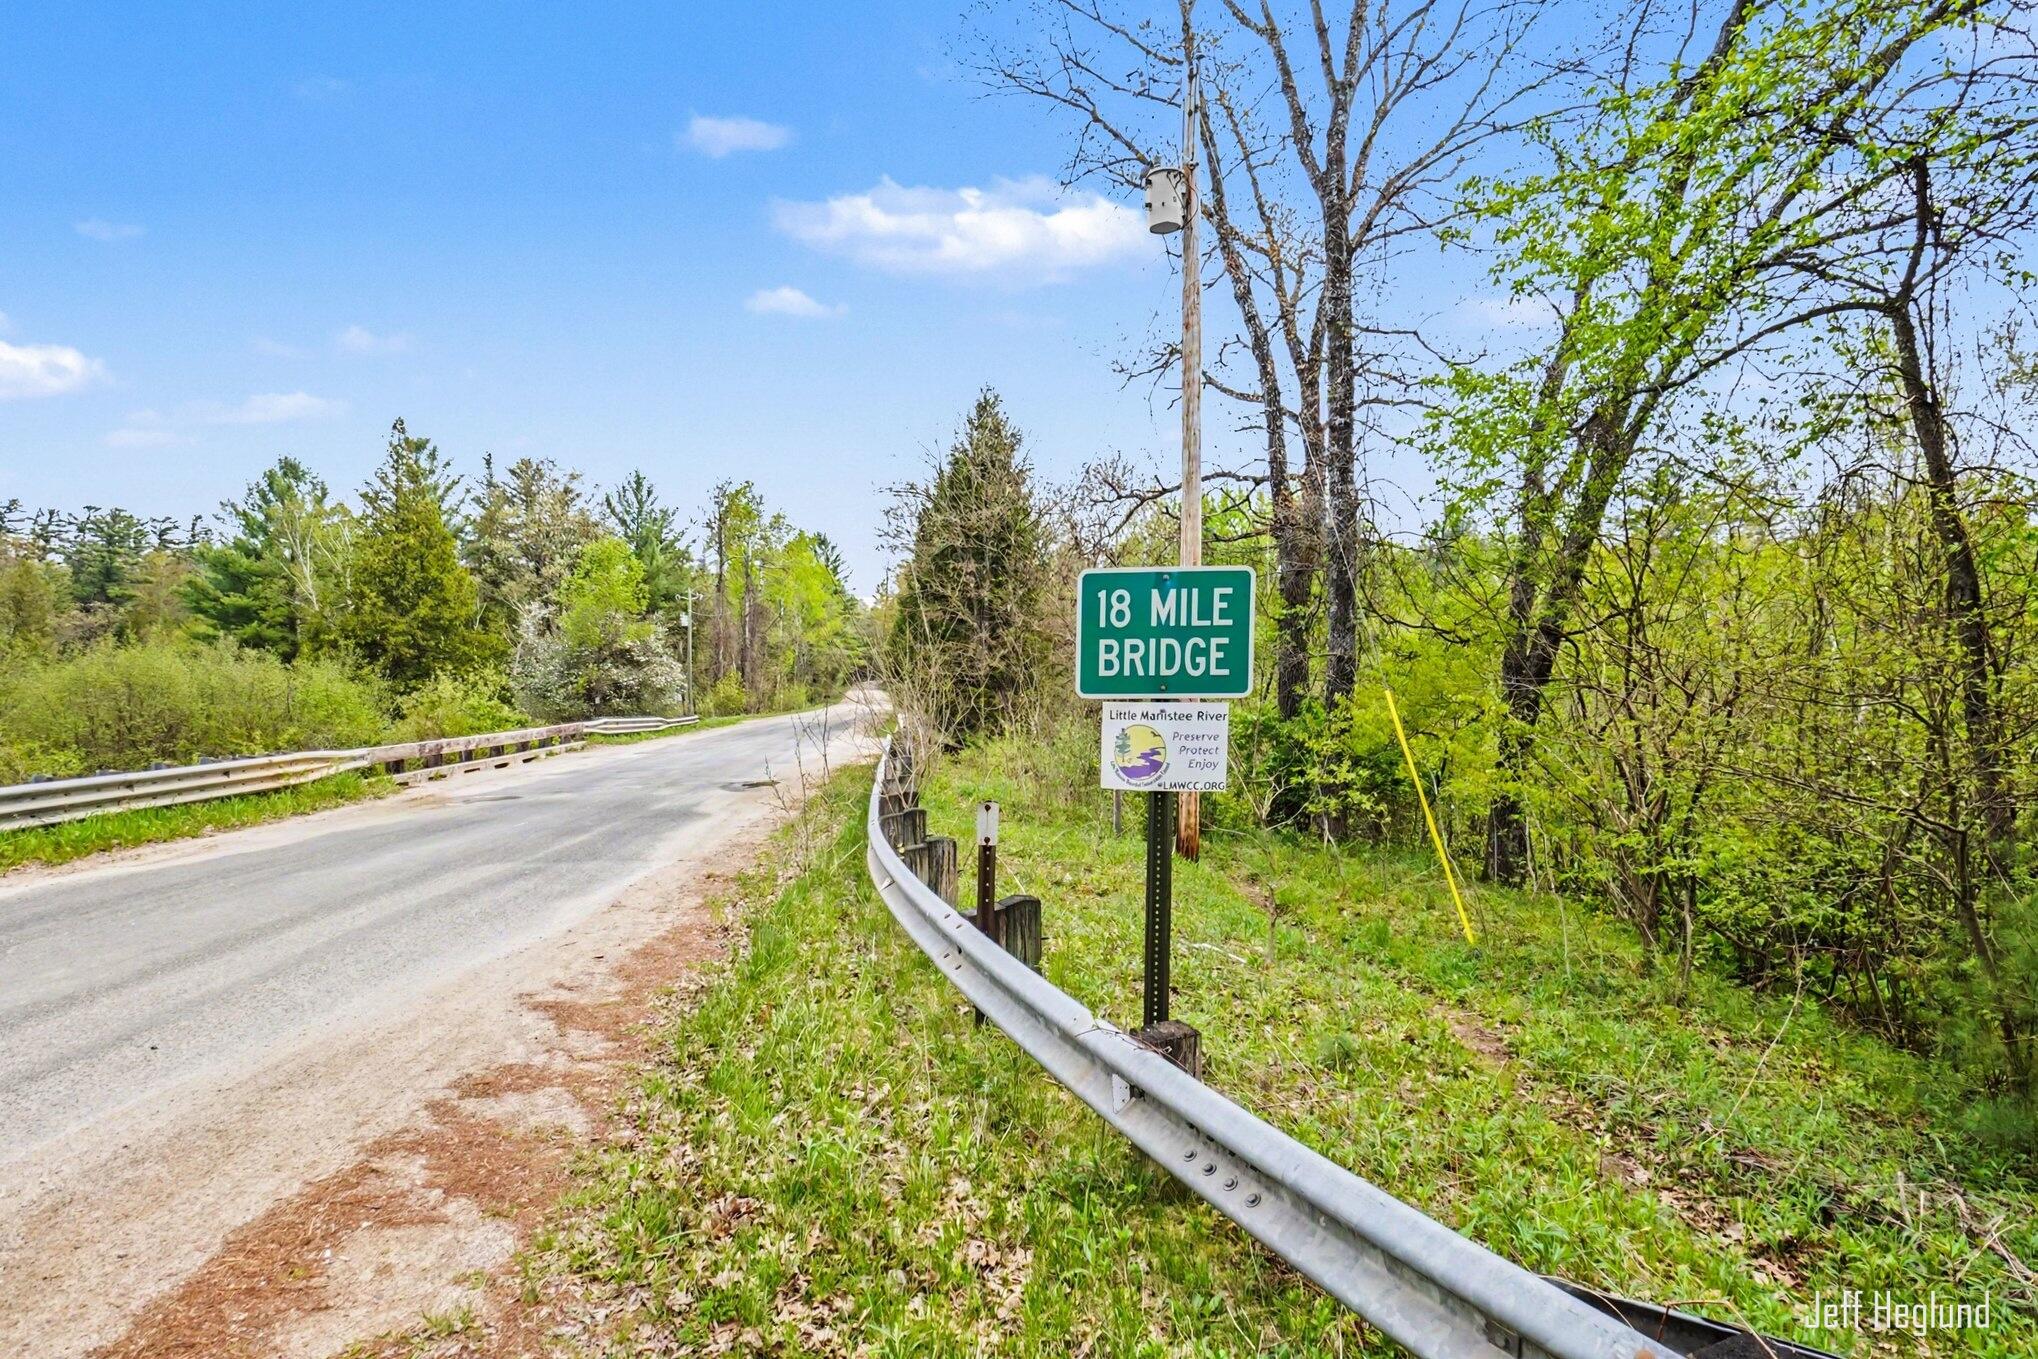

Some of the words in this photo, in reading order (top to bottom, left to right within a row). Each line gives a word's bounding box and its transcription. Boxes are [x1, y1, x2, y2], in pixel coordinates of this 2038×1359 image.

[1098, 589, 1131, 628] 18
[1150, 587, 1233, 627] MILE
[1098, 637, 1230, 677] BRIDGE
[1109, 710, 1137, 720] Little
[1141, 710, 1193, 721] Manistee
[1197, 710, 1228, 721] River
[1172, 731, 1220, 741] Preserve
[1179, 746, 1219, 755] Protect
[1188, 759, 1219, 771] Enjoy
[1163, 781, 1225, 791] LMWCC.ORG
